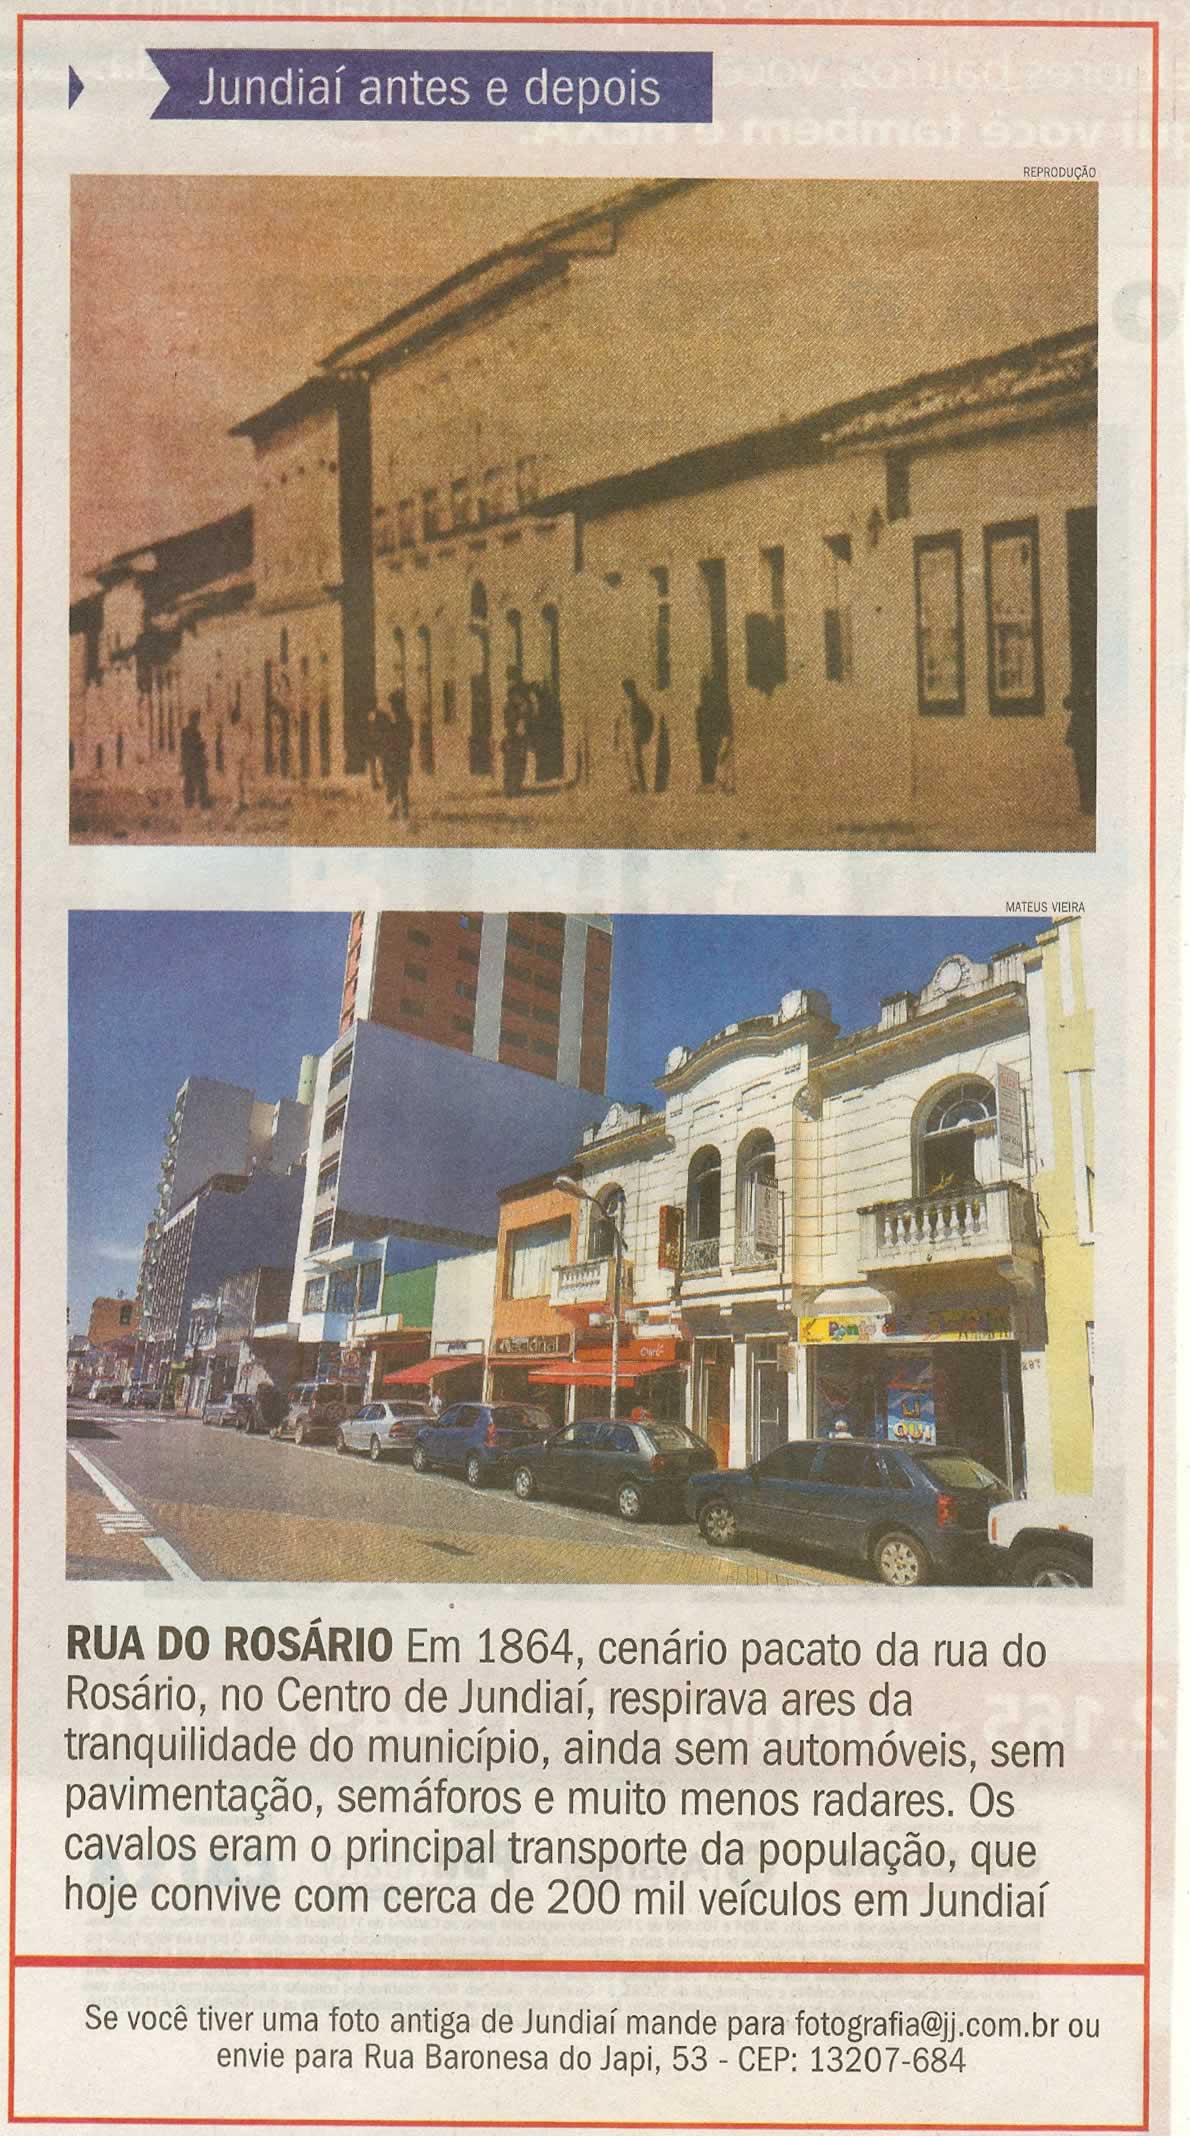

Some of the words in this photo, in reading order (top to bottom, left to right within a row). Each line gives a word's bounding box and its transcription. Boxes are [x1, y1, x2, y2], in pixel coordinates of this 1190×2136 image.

[198, 65, 344, 107] Jundiaí
[359, 70, 471, 107] antes
[486, 74, 509, 107] e
[524, 68, 661, 115] depois
[1023, 165, 1097, 180] REPRODUÇÃO
[1006, 901, 1048, 913] MATEUS
[1052, 901, 1086, 913] VIEIRA
[67, 1624, 145, 1660] RUA
[158, 1625, 210, 1661] DO
[225, 1616, 393, 1662] ROSÁRIO
[408, 1628, 460, 1663] Em
[479, 1628, 583, 1670] 1864,
[599, 1628, 727, 1666] cenário
[742, 1634, 861, 1673] pacato
[876, 1631, 918, 1667] da
[935, 1640, 987, 1667] rua
[1003, 1632, 1046, 1668] do
[67, 1673, 206, 1717] Rosário,
[222, 1684, 263, 1712] no
[278, 1676, 391, 1713] Centro
[405, 1678, 448, 1713] de
[458, 1677, 594, 1721] Jundiaí,
[610, 1680, 767, 1723] respirava
[782, 1689, 856, 1717] ares
[868, 1681, 912, 1717] da
[63, 1726, 296, 1769] tranquilidade
[309, 1727, 354, 1763] do
[369, 1726, 549, 1772] município,
[564, 1729, 661, 1765] ainda
[675, 1738, 748, 1766] sem
[763, 1729, 976, 1773] automóveis,
[991, 1740, 1064, 1768] sem
[66, 1775, 322, 1821] pavimentação,
[337, 1776, 522, 1815] semáforos
[534, 1787, 554, 1814] e
[569, 1780, 666, 1815] muito
[681, 1788, 799, 1817] menos
[813, 1781, 954, 1818] radares.
[969, 1782, 1015, 1818] Os
[64, 1825, 196, 1861] cavalos
[209, 1834, 296, 1862] eram
[311, 1835, 331, 1862] o
[347, 1828, 494, 1871] principal
[507, 1832, 687, 1873] transporte
[701, 1830, 744, 1866] da
[760, 1831, 956, 1876] população,
[971, 1840, 1036, 1875] que
[65, 1875, 137, 1919] hoje
[151, 1876, 281, 1912] convive
[295, 1885, 368, 1913] com
[383, 1886, 476, 1914] cerca
[490, 1878, 534, 1914] de
[547, 1878, 620, 1915] 200
[635, 1880, 684, 1915] mil
[698, 1878, 841, 1917] veículos
[854, 1889, 907, 1917] em
[920, 1880, 1050, 1918] Jundiaí
[85, 2004, 118, 2030] Se
[127, 2004, 188, 2031] você
[197, 2007, 254, 2031] tiver
[263, 2012, 318, 2032] uma
[332, 2006, 379, 2033] foto
[390, 2009, 470, 2040] antiga
[481, 2008, 514, 2034] de
[522, 2007, 618, 2035] Jundiaí
[627, 2009, 717, 2036] mande
[728, 2016, 785, 2041] para
[794, 2009, 1060, 2043] fotografia@jj.com.br
[1068, 2018, 1099, 2038] ou
[217, 2047, 284, 2068] envie
[295, 2048, 353, 2074] para
[365, 2043, 414, 2069] Rua
[426, 2043, 548, 2070] Baronesa
[559, 2045, 591, 2071] do
[600, 2045, 660, 2077] Japi,
[673, 2045, 707, 2072] 53
[738, 2045, 797, 2072] CEP:
[811, 2046, 966, 2073] 13207-684
